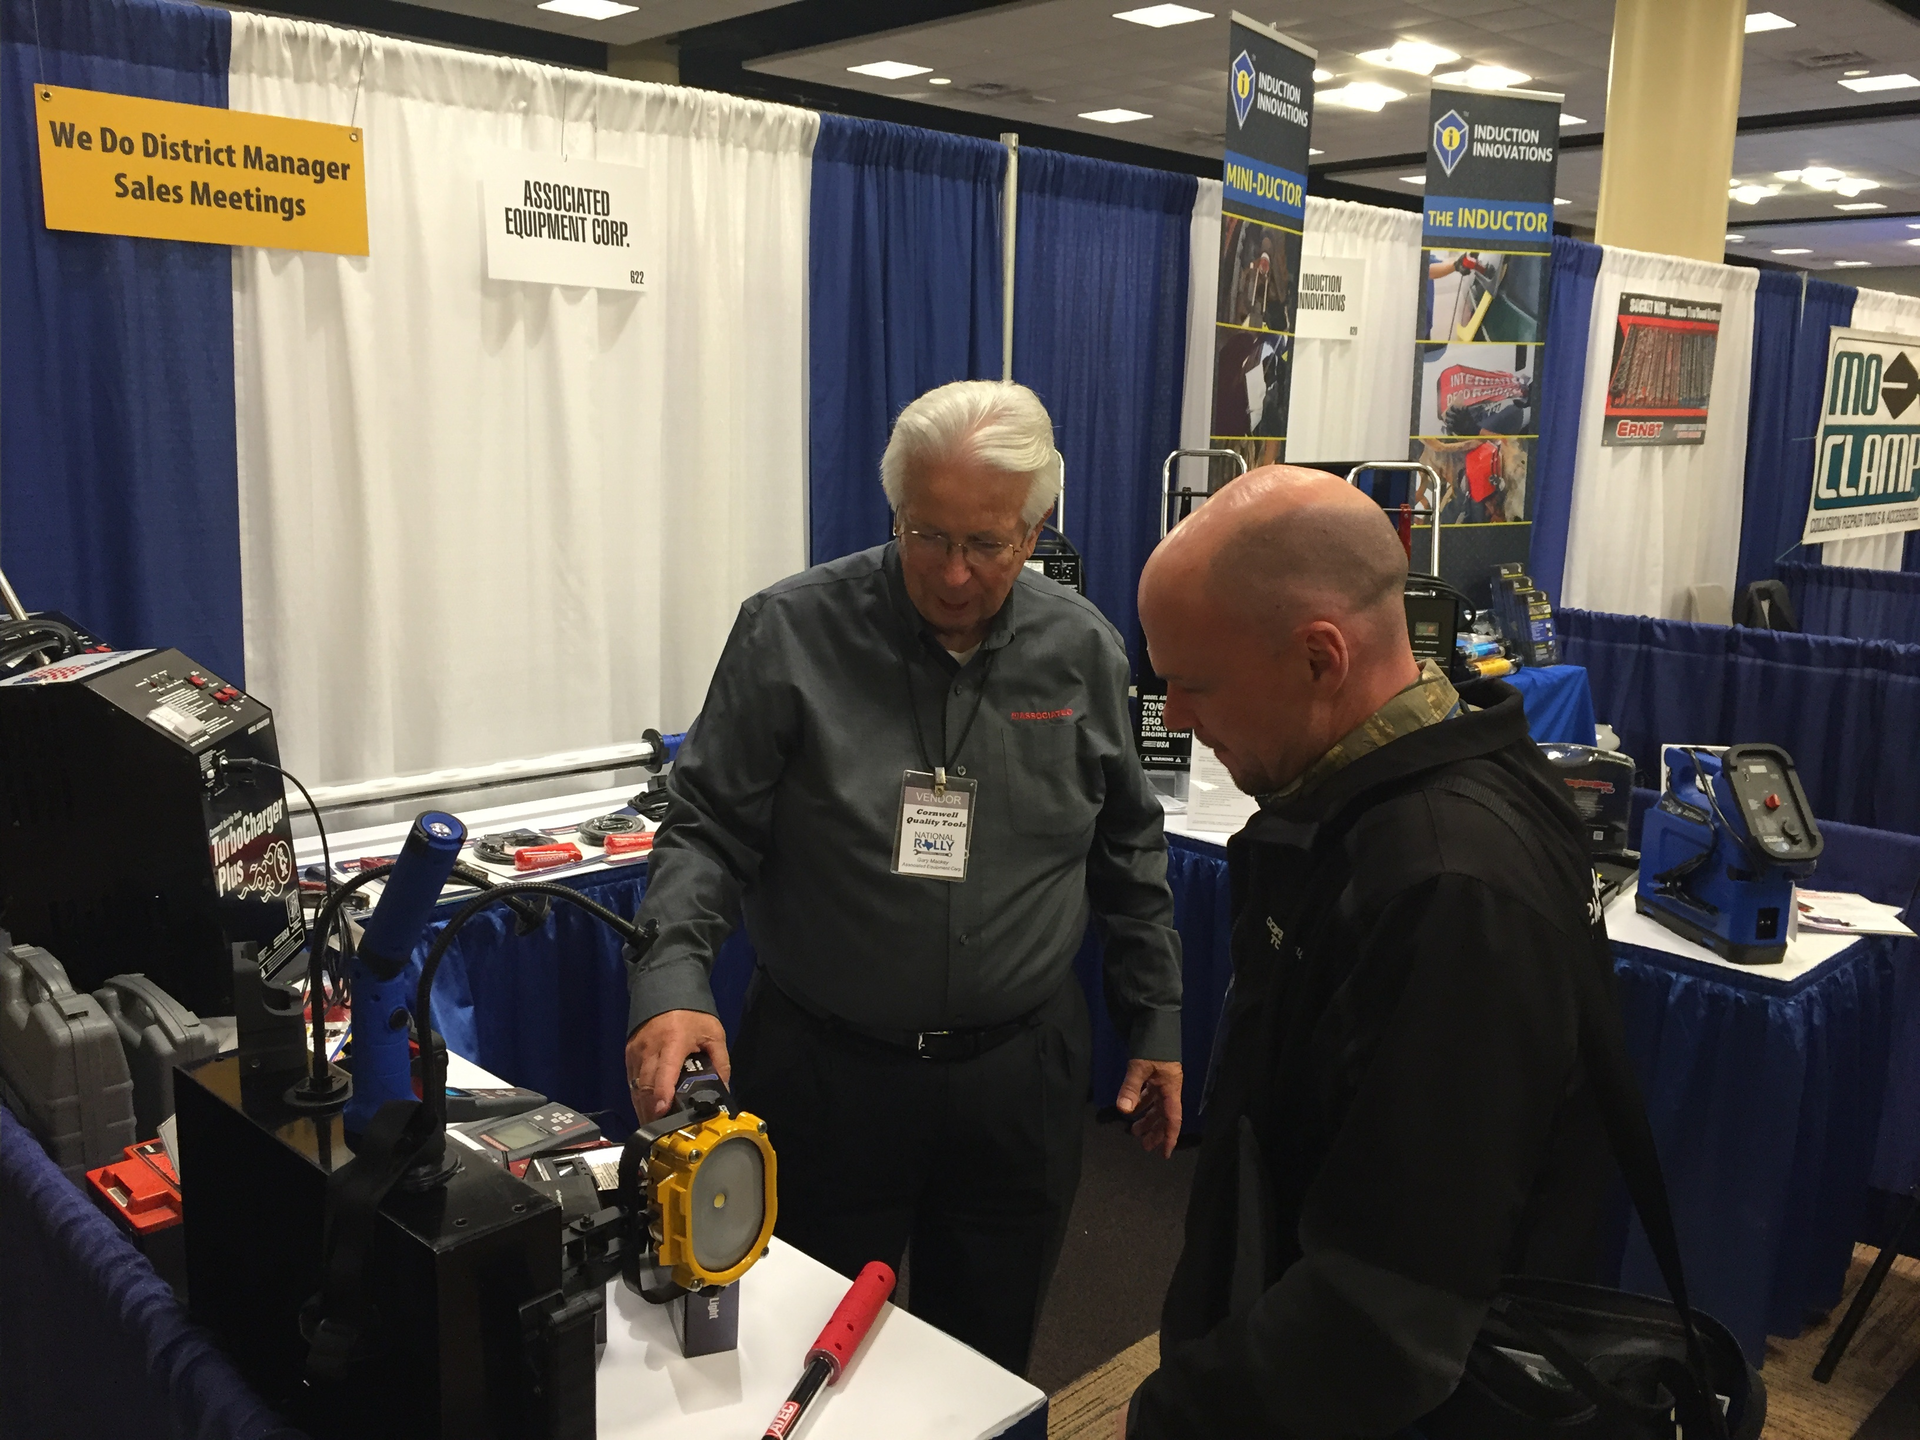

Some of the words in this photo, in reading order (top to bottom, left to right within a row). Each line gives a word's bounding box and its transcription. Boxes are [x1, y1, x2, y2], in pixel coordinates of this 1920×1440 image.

[1258, 71, 1301, 104] INDUCTION
[1256, 92, 1309, 128] INNOVATIONS
[1474, 124, 1540, 144] INDUCTION
[49, 120, 93, 151] We
[100, 126, 135, 155] Do
[142, 132, 236, 168] District
[243, 144, 350, 184] Manager
[1472, 141, 1553, 163] INNOVATIONS
[114, 172, 184, 204] Sales
[190, 180, 306, 221] Meetings
[1226, 162, 1303, 208] MINI-DUCTOR
[523, 179, 610, 217] ASSOCIATED
[504, 206, 588, 243] EQUIPMENT
[592, 217, 630, 248] CORP.
[1427, 210, 1454, 227] THE
[1457, 207, 1548, 233] INDUCTOR
[630, 269, 644, 284] 622
[1302, 272, 1342, 293] INDUCTION
[1828, 350, 1883, 416] MO
[1616, 420, 1664, 438] ERNST
[1817, 433, 1920, 499] CLAMP
[1810, 515, 1842, 533] COLLISION
[1841, 513, 1863, 529] REPAIR
[1863, 511, 1882, 527] TOOLS
[1019, 708, 1074, 720] ASSOCIATED
[1142, 702, 1166, 711] 70/6
[1141, 717, 1161, 726] 250
[906, 816, 941, 827] Quality
[942, 820, 967, 828] Tools
[916, 808, 960, 818] Cornwell
[211, 798, 284, 867] TurboCharger
[914, 831, 954, 841] NATIONAL
[217, 859, 244, 898] Plus
[708, 1297, 720, 1320] Light
